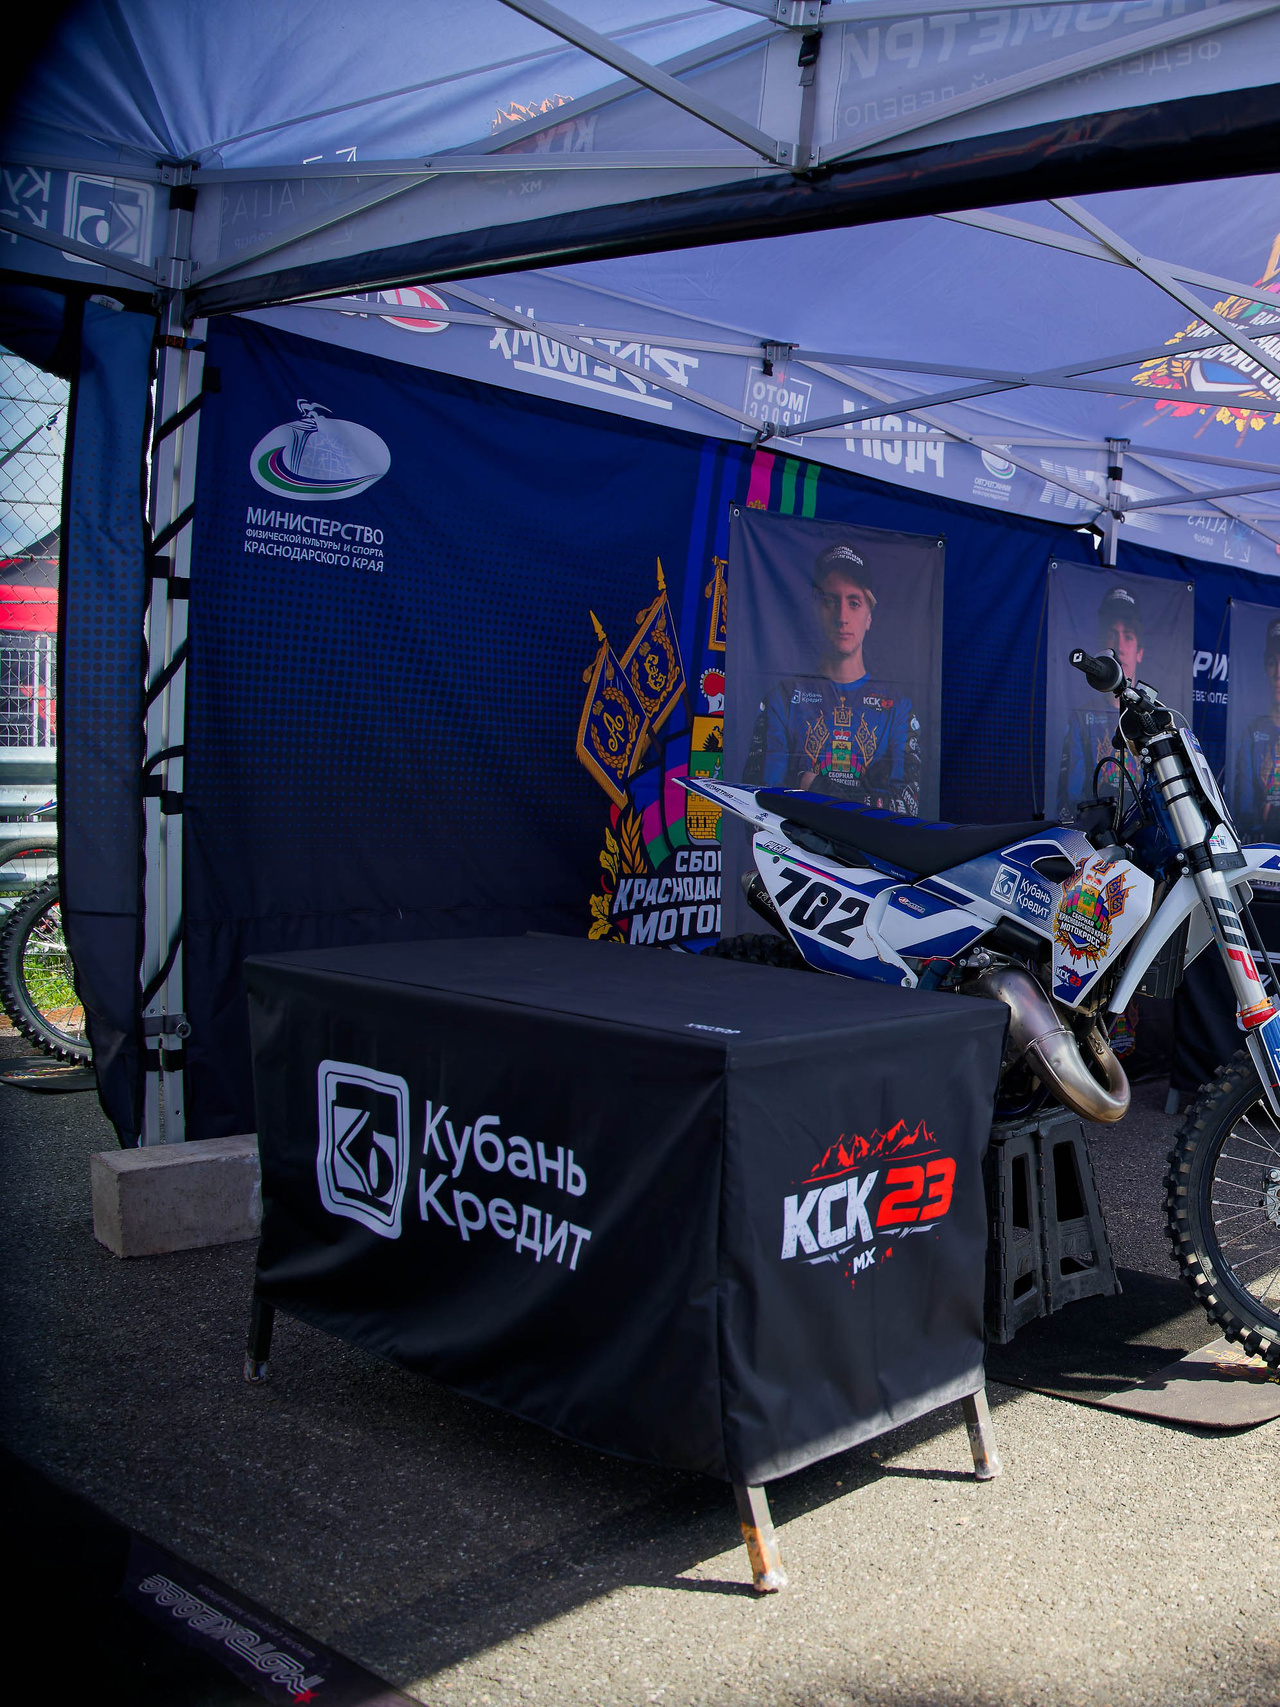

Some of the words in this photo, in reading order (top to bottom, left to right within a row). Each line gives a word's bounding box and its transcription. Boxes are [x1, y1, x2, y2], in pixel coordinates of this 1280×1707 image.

[246, 506, 385, 546] МИНИСТЕРСТВО
[244, 540, 350, 567] КРАСНОДАРСКОГО
[351, 556, 384, 573] КРАЯ
[245, 528, 301, 544] ФИЗИЧЕСКОЙ
[302, 536, 341, 551] КУЛЬТУРЫ
[343, 543, 351, 551] И
[351, 545, 384, 558] СПОРТА
[1016, 892, 1049, 918] Кредит
[1019, 878, 1051, 904] Кубань
[774, 866, 871, 948] 702
[1071, 911, 1095, 927] СБОРНАЯ
[1060, 921, 1101, 949] МОТОКРОСС
[423, 1099, 589, 1198] Кубань
[417, 1171, 593, 1272] Кредит
[780, 1168, 877, 1260] КСК
[875, 1157, 957, 1228] 23
[852, 1245, 876, 1275] MX
